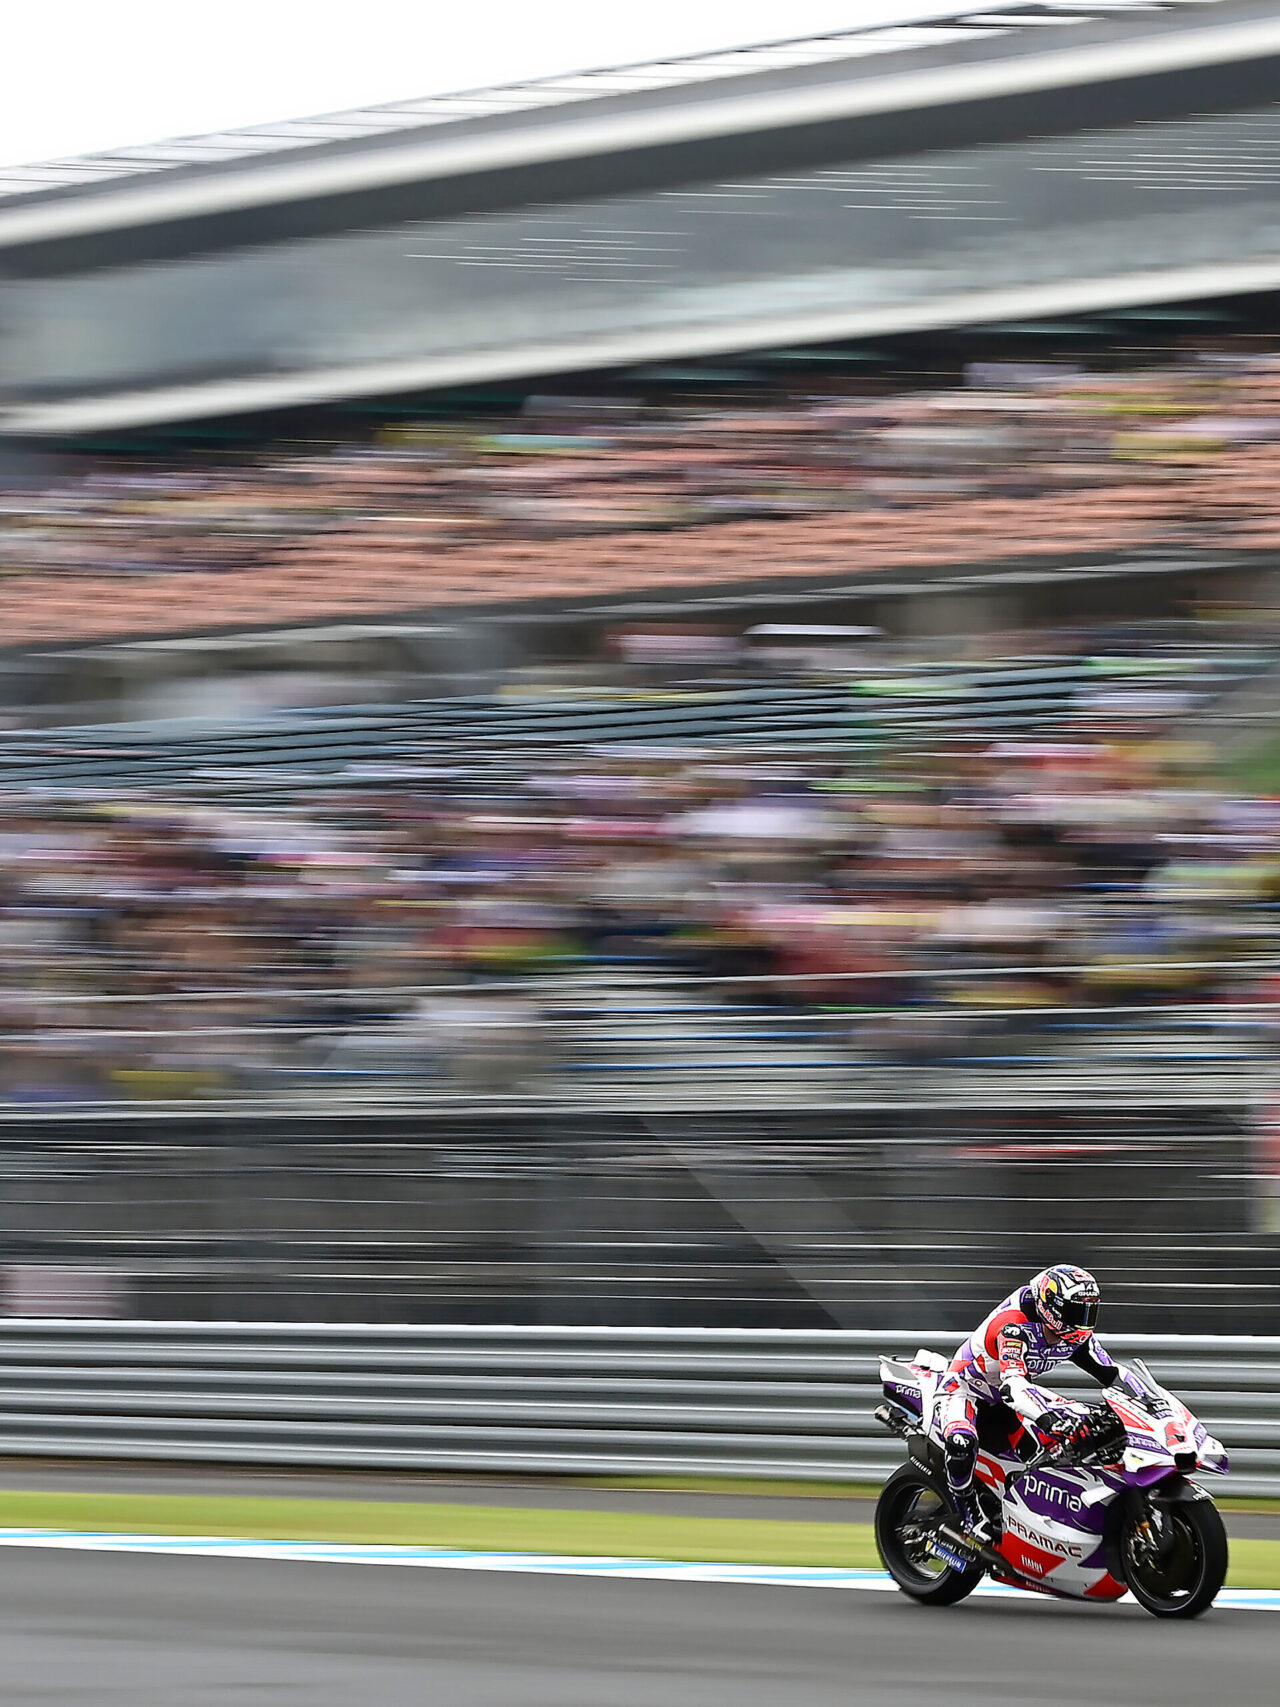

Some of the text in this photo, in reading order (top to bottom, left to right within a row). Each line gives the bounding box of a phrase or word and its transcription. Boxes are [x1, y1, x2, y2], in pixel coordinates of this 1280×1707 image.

[895, 1385, 921, 1399] prima
[1023, 1474, 1083, 1513] prima
[1008, 1515, 1083, 1559] PRAMAC
